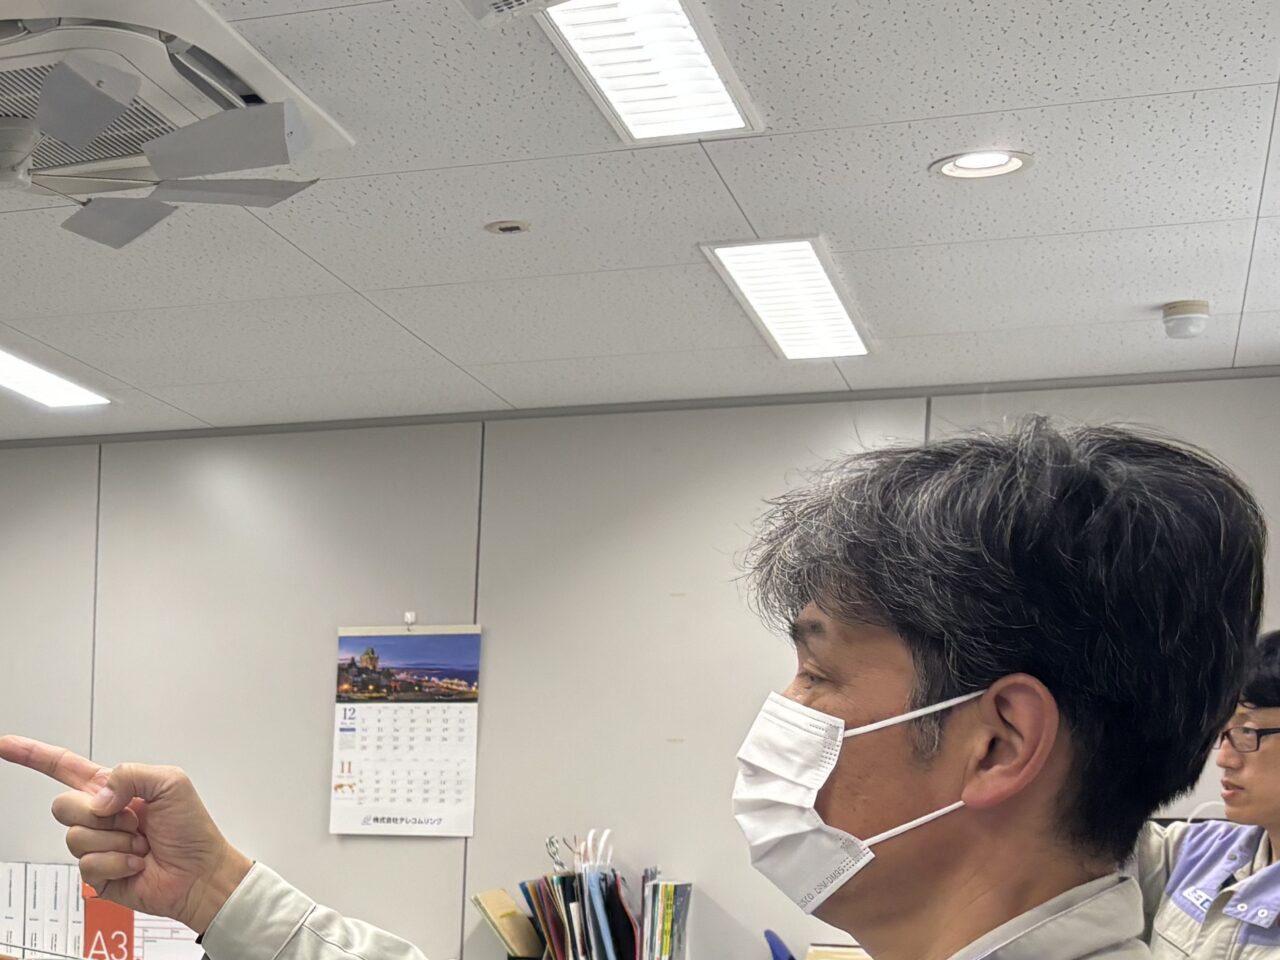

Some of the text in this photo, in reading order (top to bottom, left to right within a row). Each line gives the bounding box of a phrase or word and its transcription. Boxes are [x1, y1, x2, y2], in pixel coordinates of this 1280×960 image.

[343, 707, 356, 720] 12
[341, 761, 351, 774] 11
[372, 816, 442, 826] 株式会社テレコムリンク
